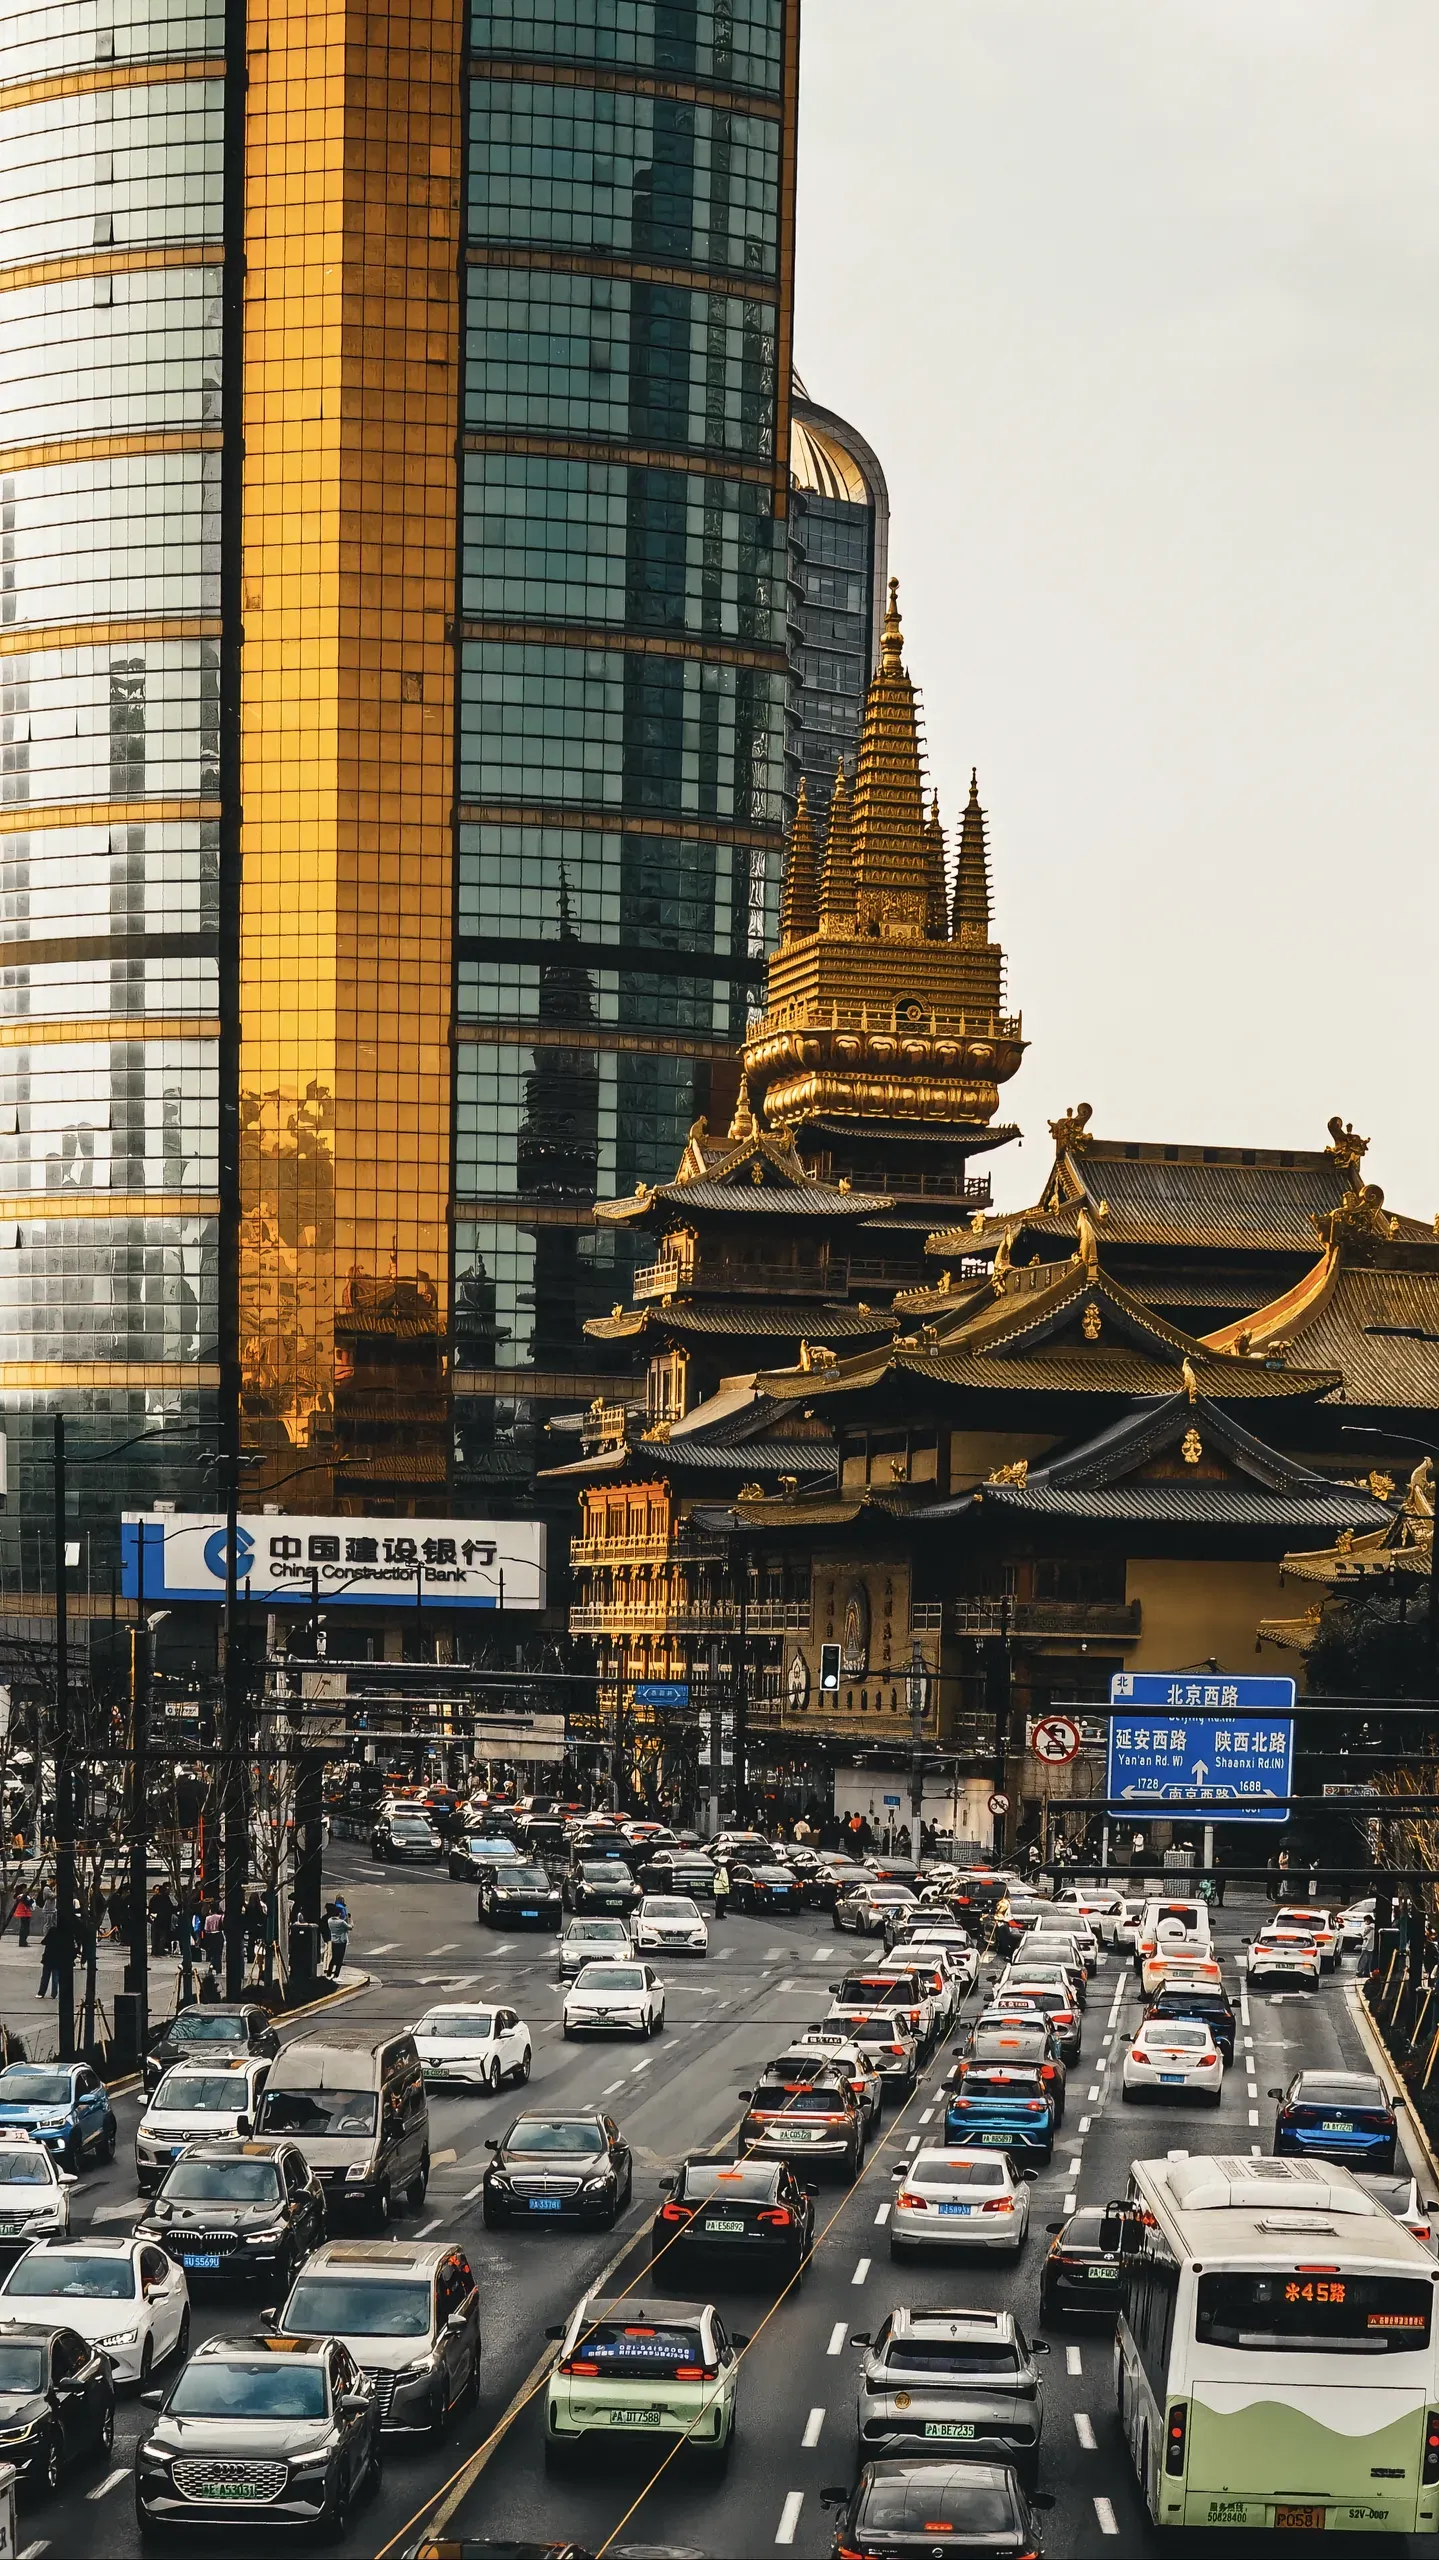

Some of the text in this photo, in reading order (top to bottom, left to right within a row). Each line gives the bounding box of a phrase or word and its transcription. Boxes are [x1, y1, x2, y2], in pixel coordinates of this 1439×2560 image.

[269, 1535, 498, 1566] 中国建设银行
[269, 1562, 467, 1582] China Construction Bank
[1117, 1676, 1128, 1687] 北
[1167, 1684, 1238, 1706] 北京西路
[1116, 1728, 1187, 1751] 延安西路
[1215, 1730, 1286, 1753] 陕西北路
[1118, 1754, 1151, 1766] Yan'an
[1215, 1756, 1284, 1769] Shaanxi Rd.(N)
[1137, 1777, 1158, 1789] 1728
[1239, 1780, 1261, 1792] 1688
